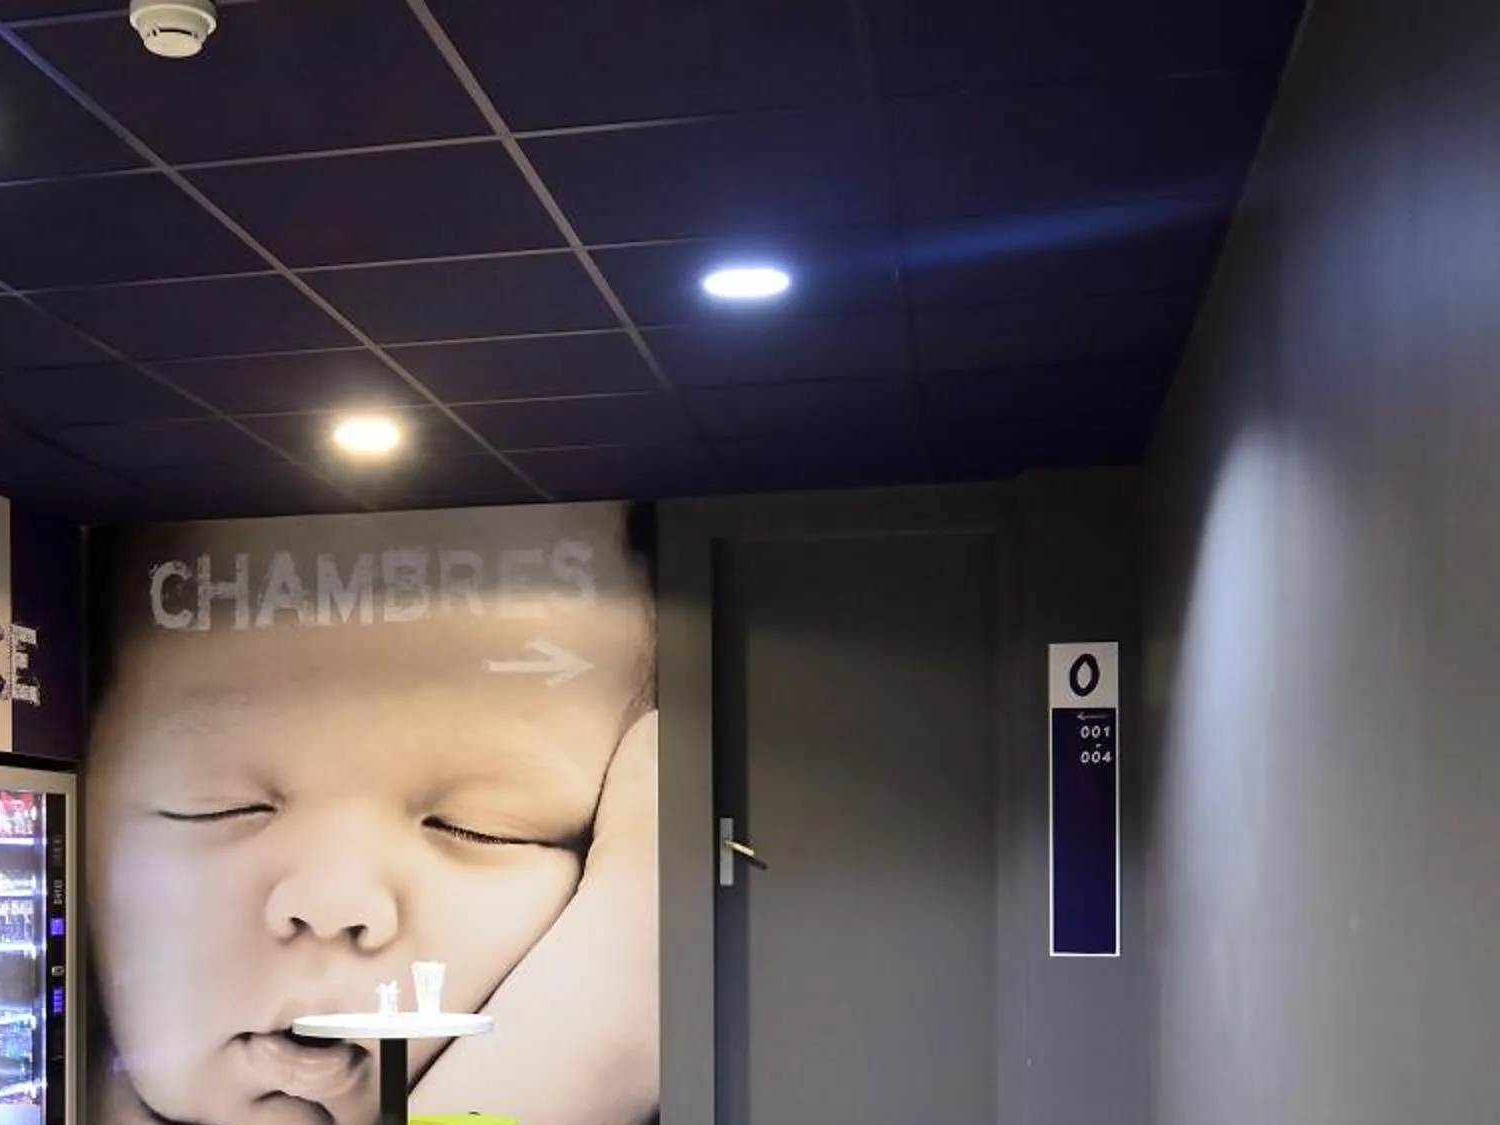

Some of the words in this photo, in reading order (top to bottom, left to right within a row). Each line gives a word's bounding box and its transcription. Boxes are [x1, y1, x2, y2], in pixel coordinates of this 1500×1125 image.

[149, 539, 598, 632] CHAMBRES
[1069, 653, 1100, 697] 0
[1080, 725, 1111, 739] 001
[1080, 751, 1112, 764] 004
